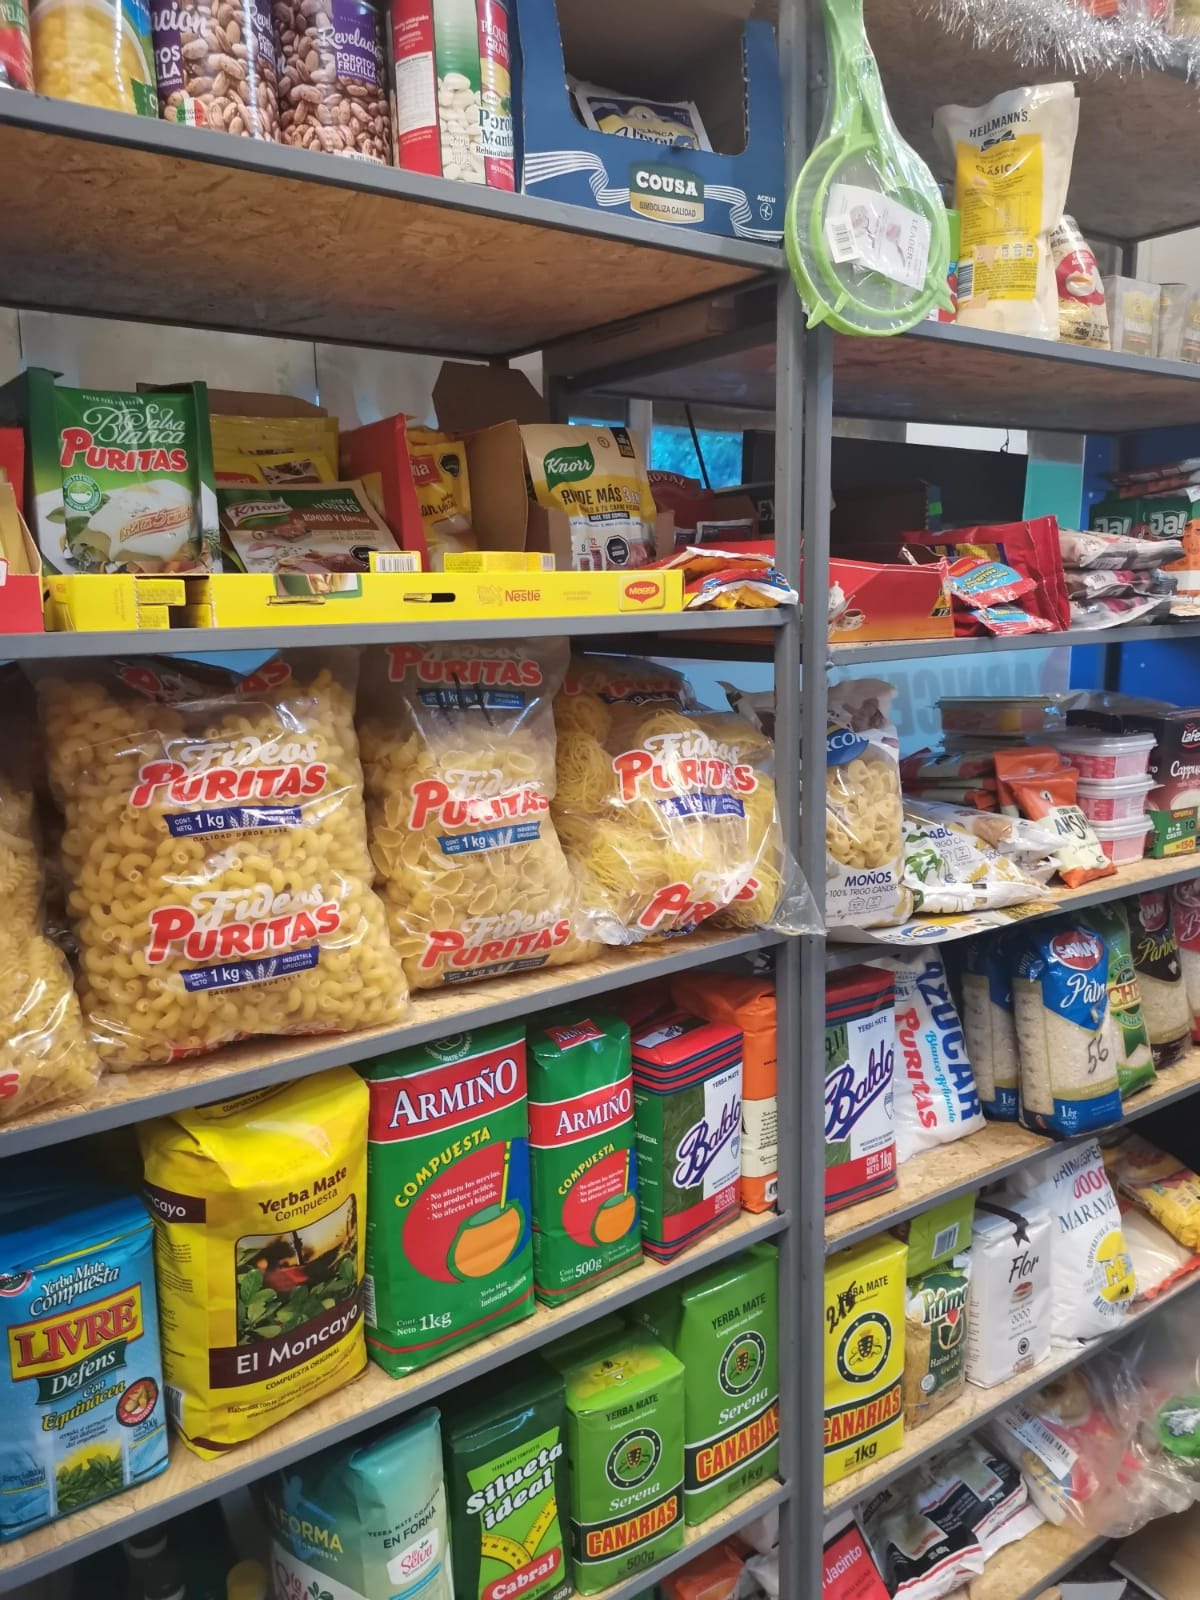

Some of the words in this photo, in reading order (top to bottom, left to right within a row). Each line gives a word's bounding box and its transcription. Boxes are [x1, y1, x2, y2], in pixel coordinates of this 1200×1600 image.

[336, 52, 376, 72] POROTOS
[337, 61, 376, 78] FRUTILLA
[636, 170, 698, 197] COUSA
[639, 201, 671, 214] SIMBOLIZA
[671, 207, 697, 218] CALIDAD
[83, 406, 186, 445] Blanca
[129, 404, 186, 430] Salsa
[60, 427, 188, 472] PURITAS
[546, 456, 593, 474] Knorr
[596, 484, 622, 503] MÁS
[1150, 510, 1187, 536] Ja!
[628, 585, 658, 597] Maggi
[386, 645, 543, 686] PURITAS
[181, 736, 320, 772] Fideos
[130, 758, 329, 808] PURITAS
[175, 824, 193, 834] NETO
[194, 813, 203, 830] 1
[207, 813, 225, 833] kg
[462, 837, 470, 850] 1
[471, 834, 486, 852] kg
[845, 871, 892, 887] MOÑOS
[849, 887, 870, 896] TRIGO
[145, 901, 343, 964] PURITAS
[418, 919, 571, 969] PURITAS
[210, 969, 218, 983] 1
[221, 966, 240, 985] kg
[282, 953, 313, 964] INDUSTRIA
[916, 961, 981, 1122] AZUCAR
[894, 1007, 938, 1130] PURITAS
[388, 1058, 519, 1130] ARMIÑO
[825, 1039, 894, 1143] Baldo
[555, 1088, 631, 1137] ARMIÑO
[673, 1094, 741, 1188] Baldo
[393, 1126, 492, 1209] COMPUESTA
[557, 1143, 615, 1196] COMPUESTA
[880, 1150, 893, 1172] 1kg
[152, 1197, 187, 1218] cayo
[258, 1186, 310, 1216] Yerba
[313, 1166, 348, 1197] Mate
[275, 1188, 338, 1223] Compuesta
[41, 1275, 74, 1298] Yerba
[75, 1261, 105, 1281] Mate
[575, 1258, 602, 1278] 500g
[866, 1274, 889, 1295] MATE
[1008, 1250, 1040, 1284] Flor
[29, 1266, 120, 1317] Compuesta
[419, 1311, 452, 1332] 1kg
[711, 1309, 741, 1331] YERBA
[742, 1292, 767, 1314] MATE
[14, 1295, 139, 1368] LIVRE
[236, 1352, 258, 1375] El
[268, 1303, 358, 1368] Moncayo
[397, 1327, 417, 1337] Neto
[51, 1349, 116, 1396] Defens
[265, 1365, 310, 1391] COMPUESTA
[309, 1347, 340, 1371] ORIGINAL
[605, 1405, 634, 1423] YERBA
[635, 1392, 660, 1410] MATE
[717, 1386, 769, 1425] Serena
[853, 1440, 877, 1465] 1kg
[466, 1441, 563, 1515] Silueta
[609, 1480, 661, 1512] Serena
[483, 1467, 553, 1531] ideal
[280, 1507, 344, 1554] FORMA
[368, 1528, 392, 1538] YERBA
[395, 1517, 412, 1531] MATE
[383, 1535, 401, 1550] EN
[403, 1505, 437, 1542] FORMA
[586, 1494, 678, 1558] CANARIAS
[400, 1543, 433, 1576] Selva
[626, 1548, 655, 1572] 500g
[825, 1545, 862, 1583] Jacinto
[491, 1556, 555, 1600] Cabral
